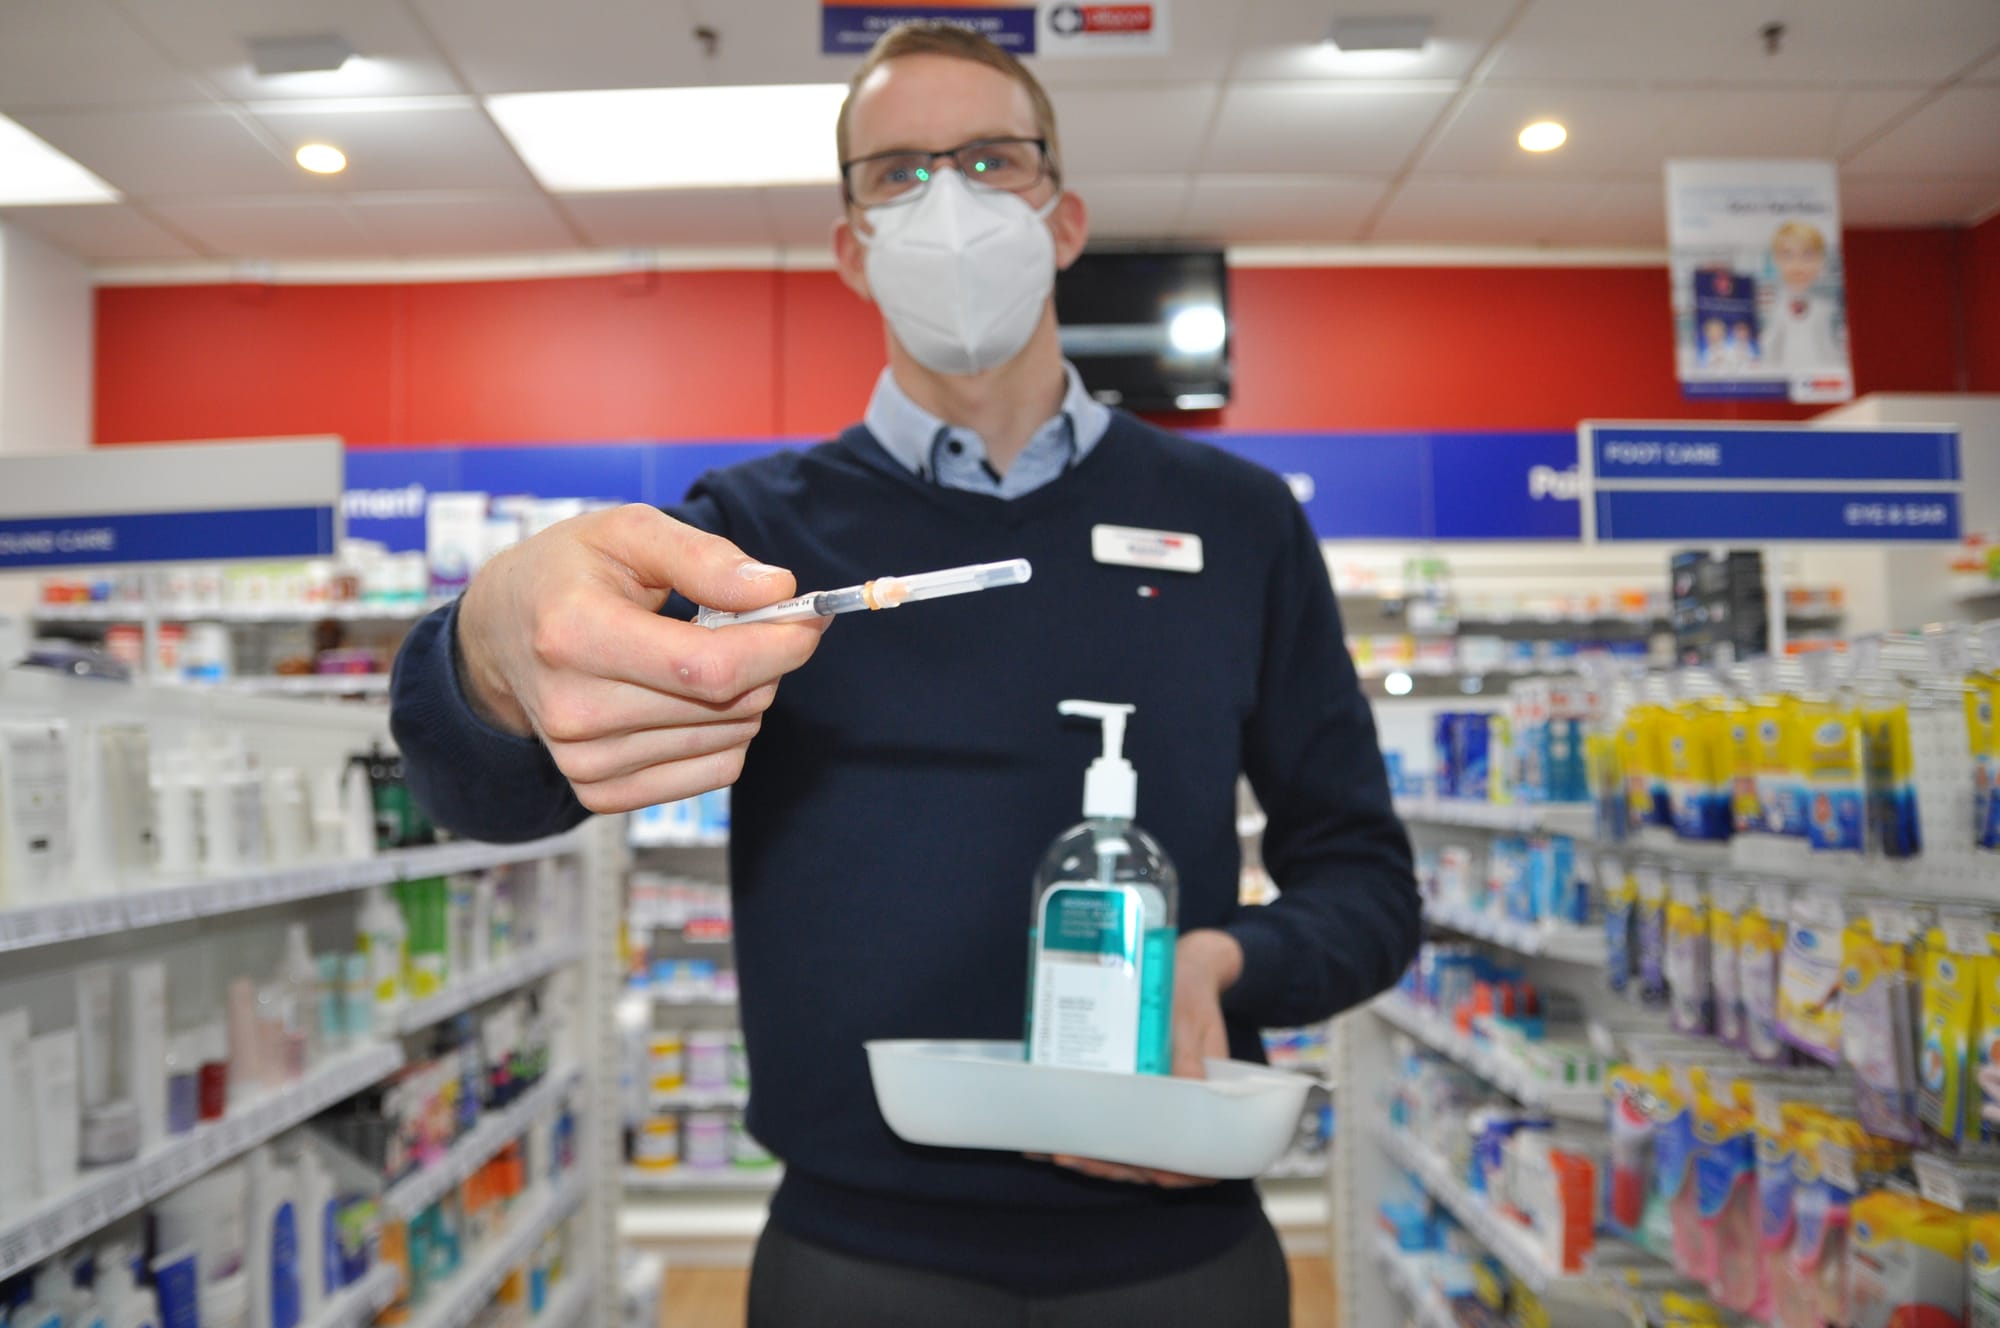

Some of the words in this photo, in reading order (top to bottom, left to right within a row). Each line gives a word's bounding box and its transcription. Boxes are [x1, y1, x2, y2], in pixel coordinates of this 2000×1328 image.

[1606, 442, 1661, 464] FOOT
[1665, 443, 1721, 466] CARE
[1846, 504, 1886, 525] EYE
[56, 527, 114, 553] CARE
